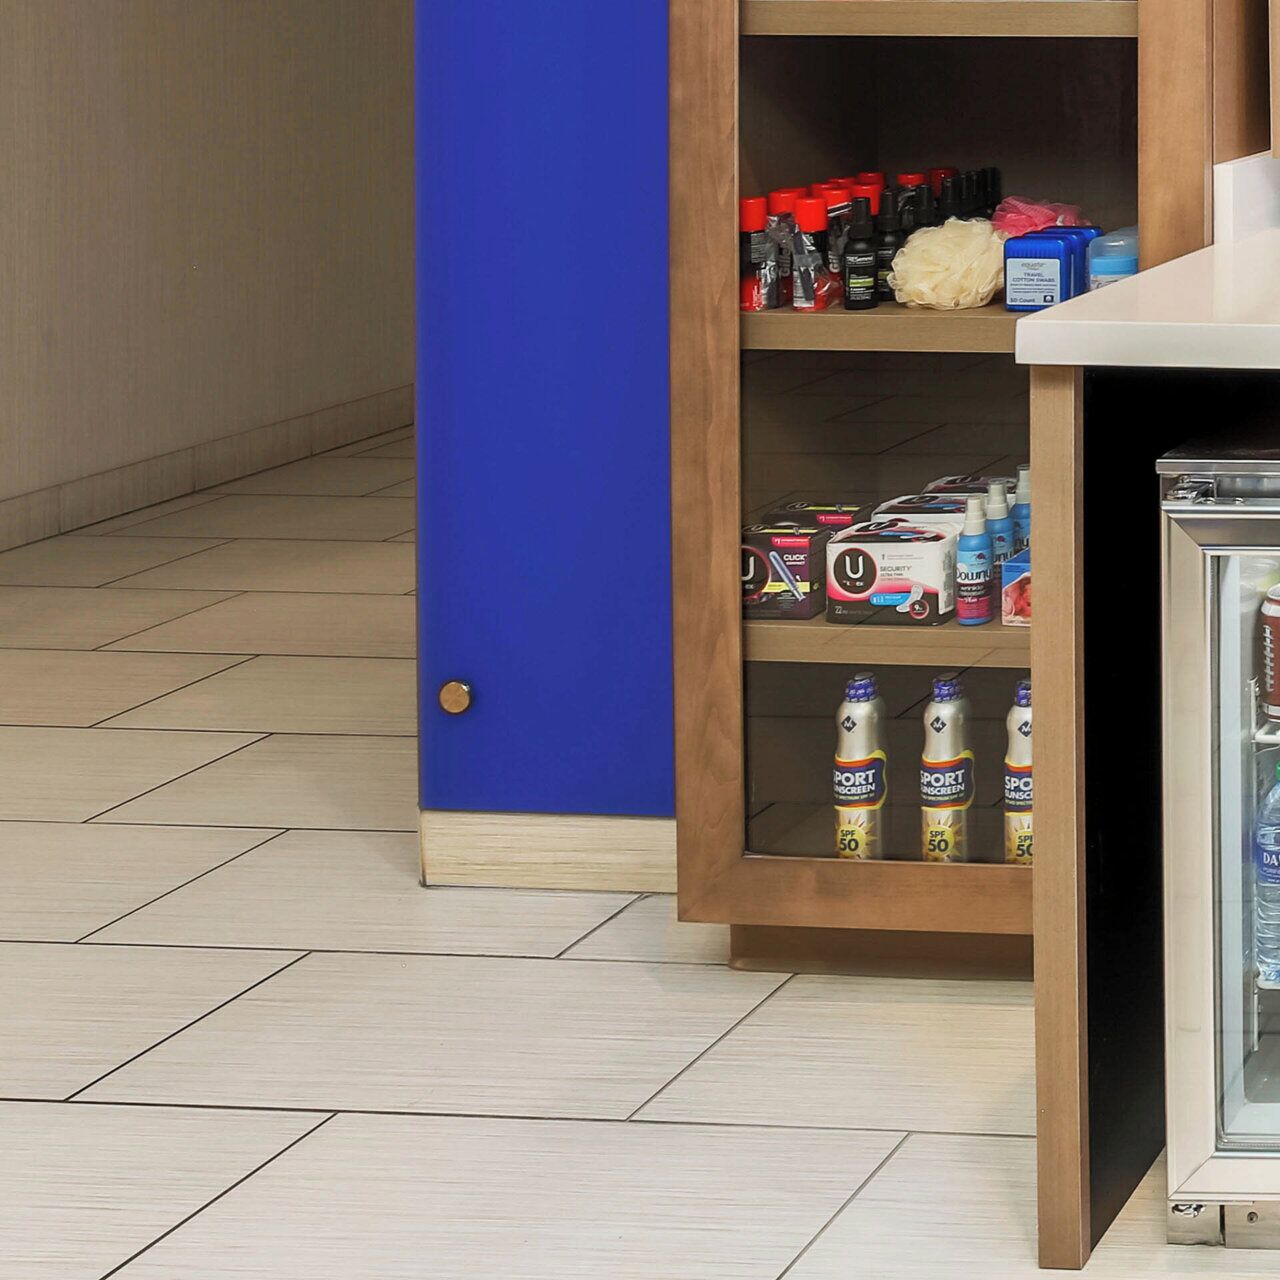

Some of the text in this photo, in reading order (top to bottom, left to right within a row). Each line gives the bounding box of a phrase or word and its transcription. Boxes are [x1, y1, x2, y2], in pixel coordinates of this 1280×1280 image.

[783, 554, 805, 562] CLICK
[845, 555, 864, 579] U
[840, 829, 855, 838] SPF
[929, 830, 945, 838] SPF
[839, 838, 859, 852] 50
[927, 838, 949, 852] 50
